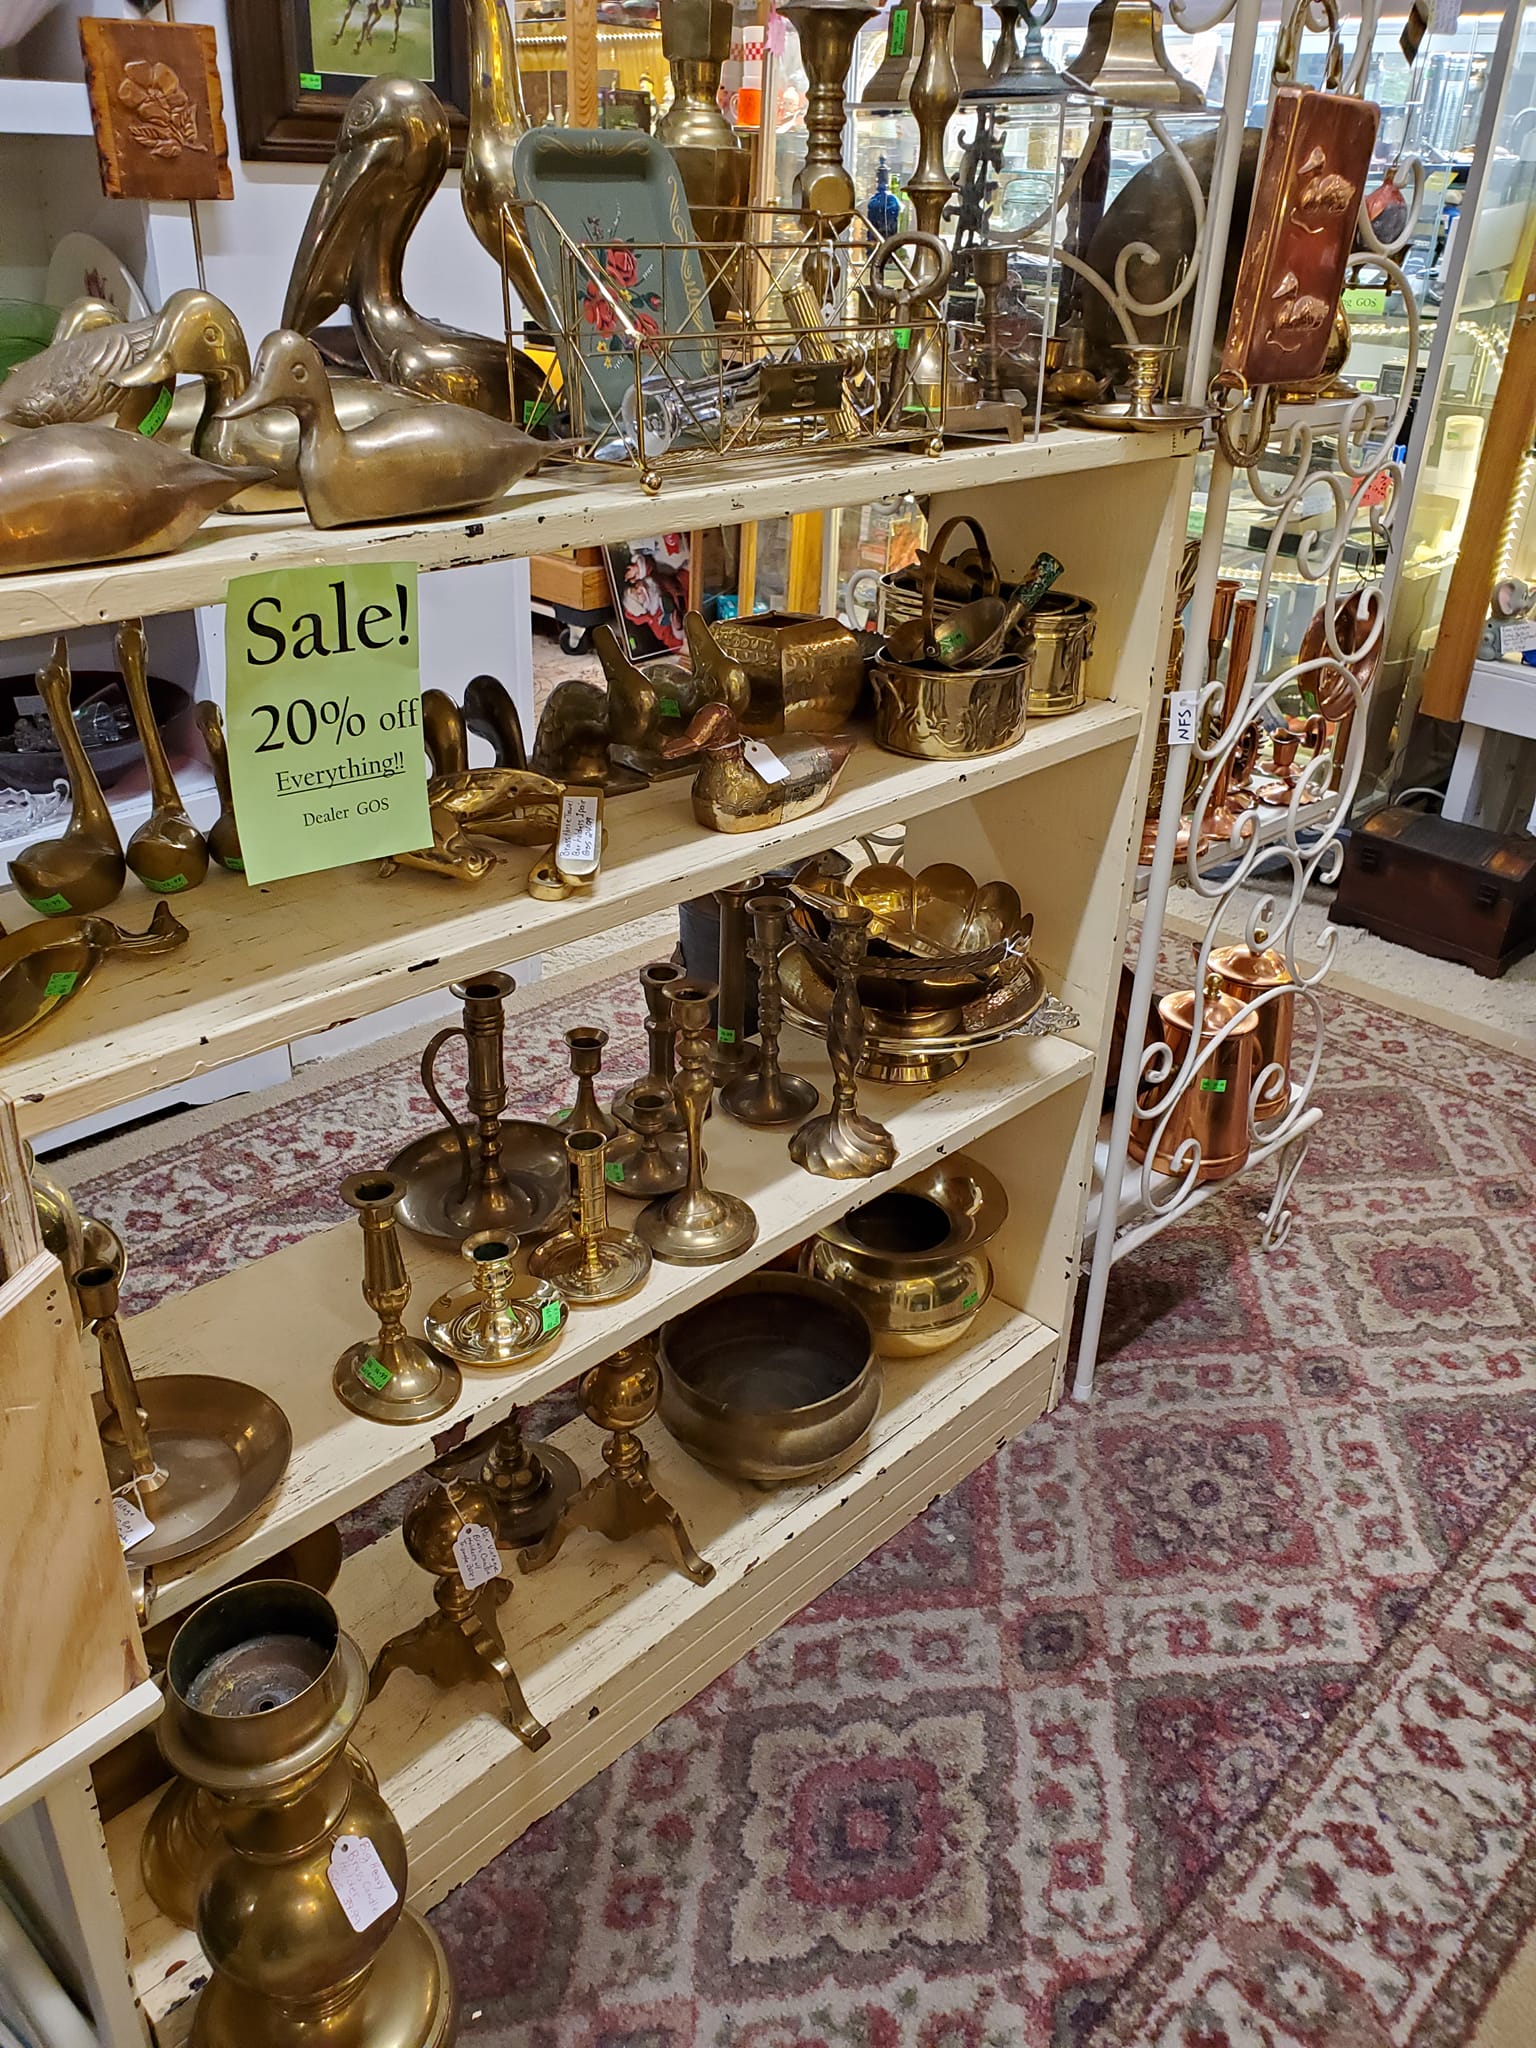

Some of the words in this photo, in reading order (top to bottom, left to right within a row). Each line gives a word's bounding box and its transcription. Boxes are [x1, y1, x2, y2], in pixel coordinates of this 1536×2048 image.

[1356, 297, 1377, 308] GOS
[247, 580, 410, 666] Sale!
[250, 695, 366, 754] 20%
[379, 697, 420, 732] off
[1177, 709, 1192, 740] NFS
[275, 751, 406, 793] Everything!!
[303, 806, 351, 828] Dealer
[356, 797, 390, 816] GOS
